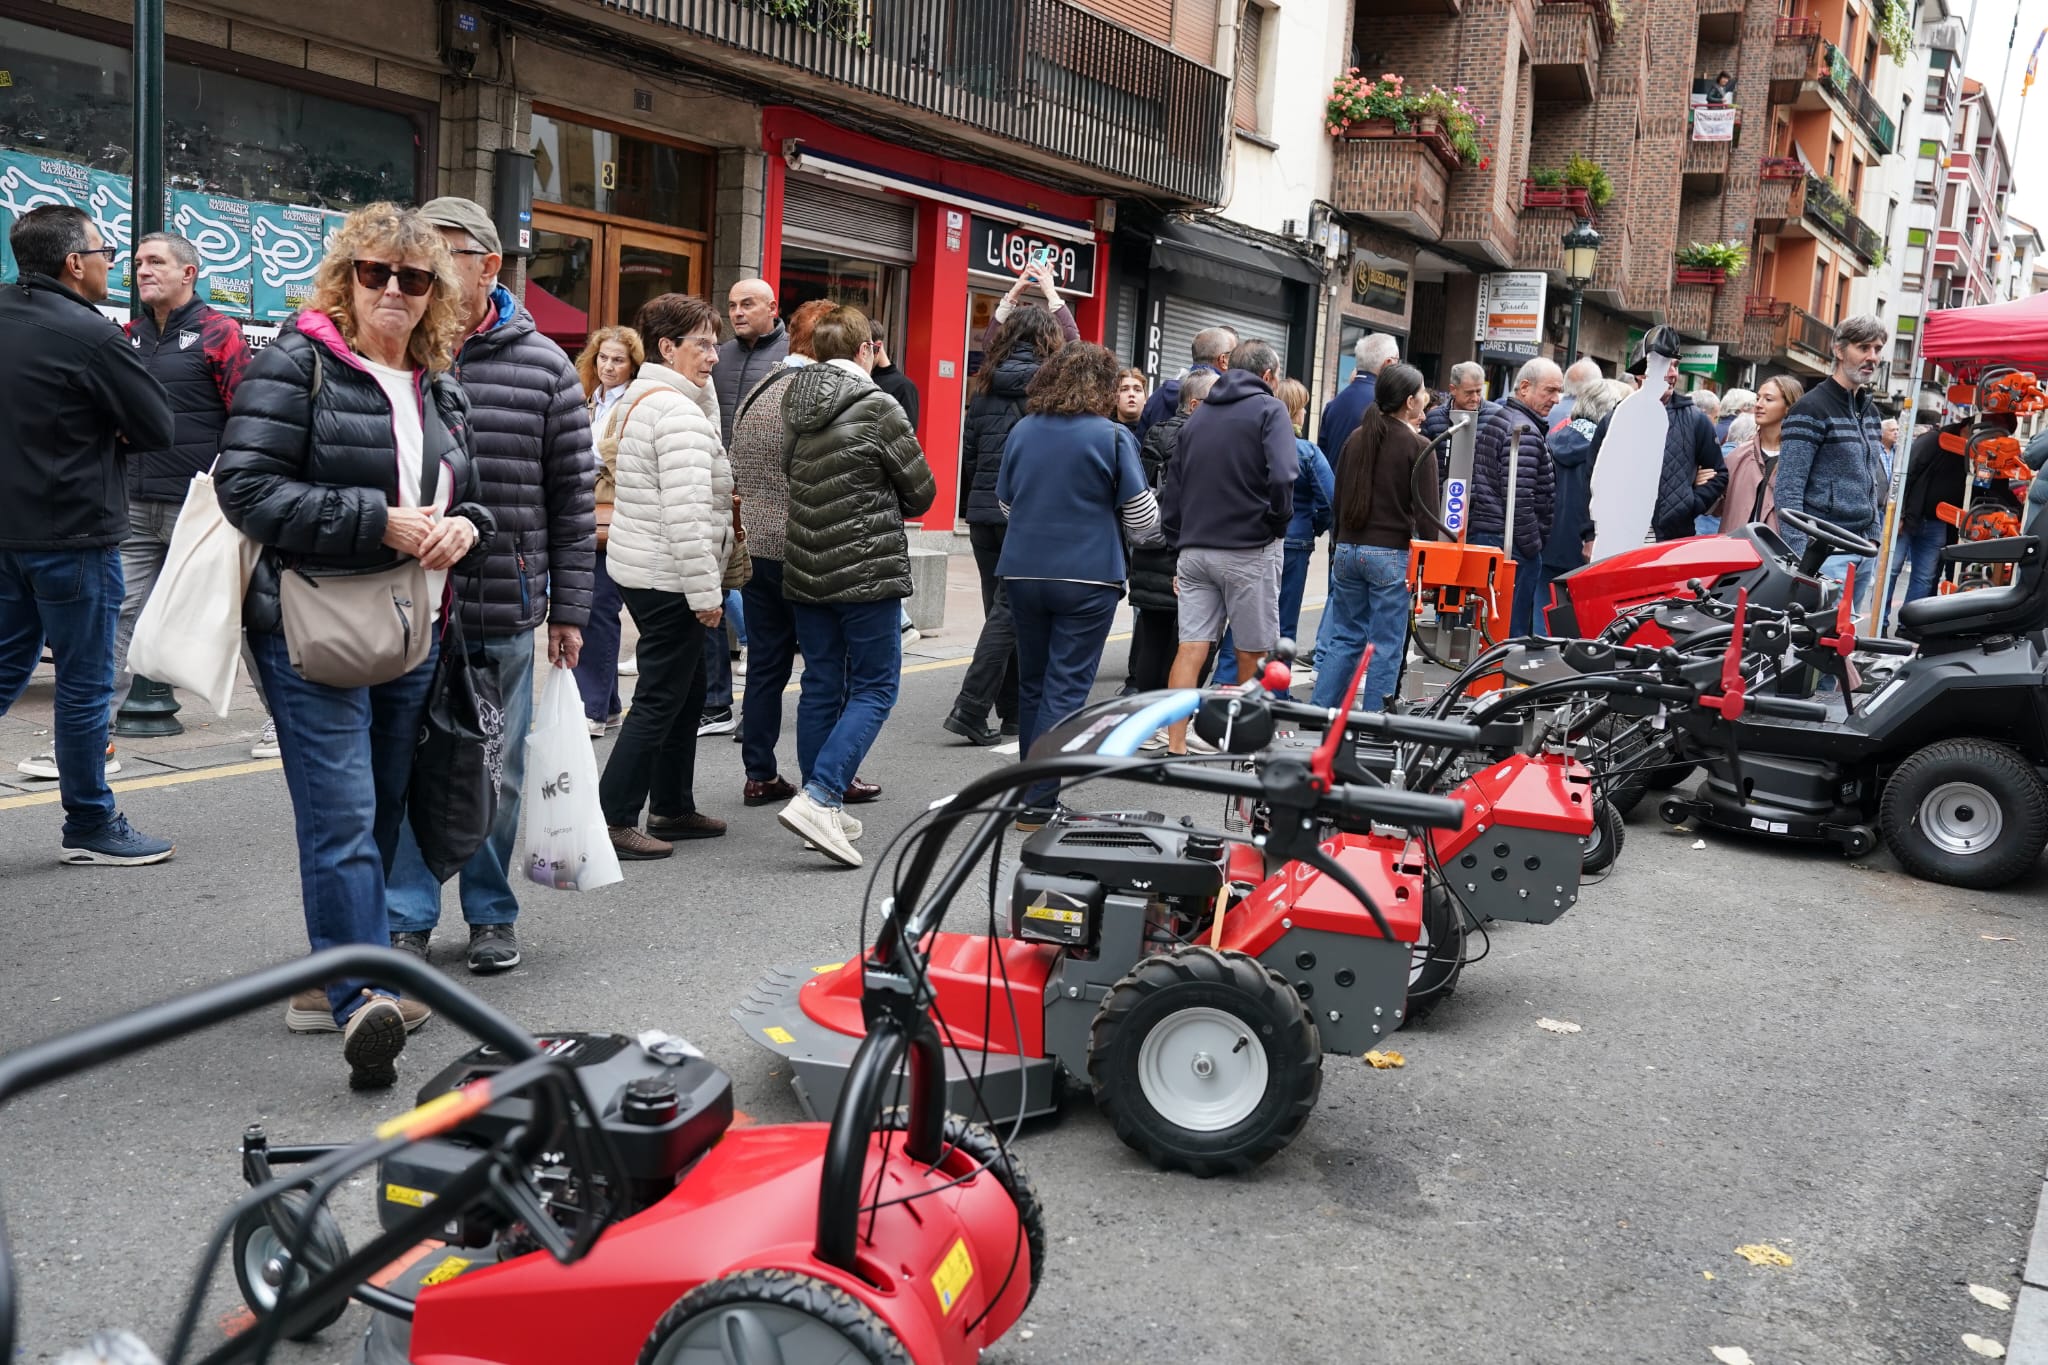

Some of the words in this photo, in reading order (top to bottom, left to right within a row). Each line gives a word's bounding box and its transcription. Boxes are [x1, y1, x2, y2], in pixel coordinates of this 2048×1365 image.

[40, 165, 89, 181] NAZIONALA
[603, 164, 613, 186] 3
[209, 202, 249, 215] NAZIONALA
[210, 275, 250, 287] EUSKARAZ
[286, 283, 313, 292] EUSKAR
[1484, 340, 1506, 352] GARES
[1507, 342, 1513, 353] &
